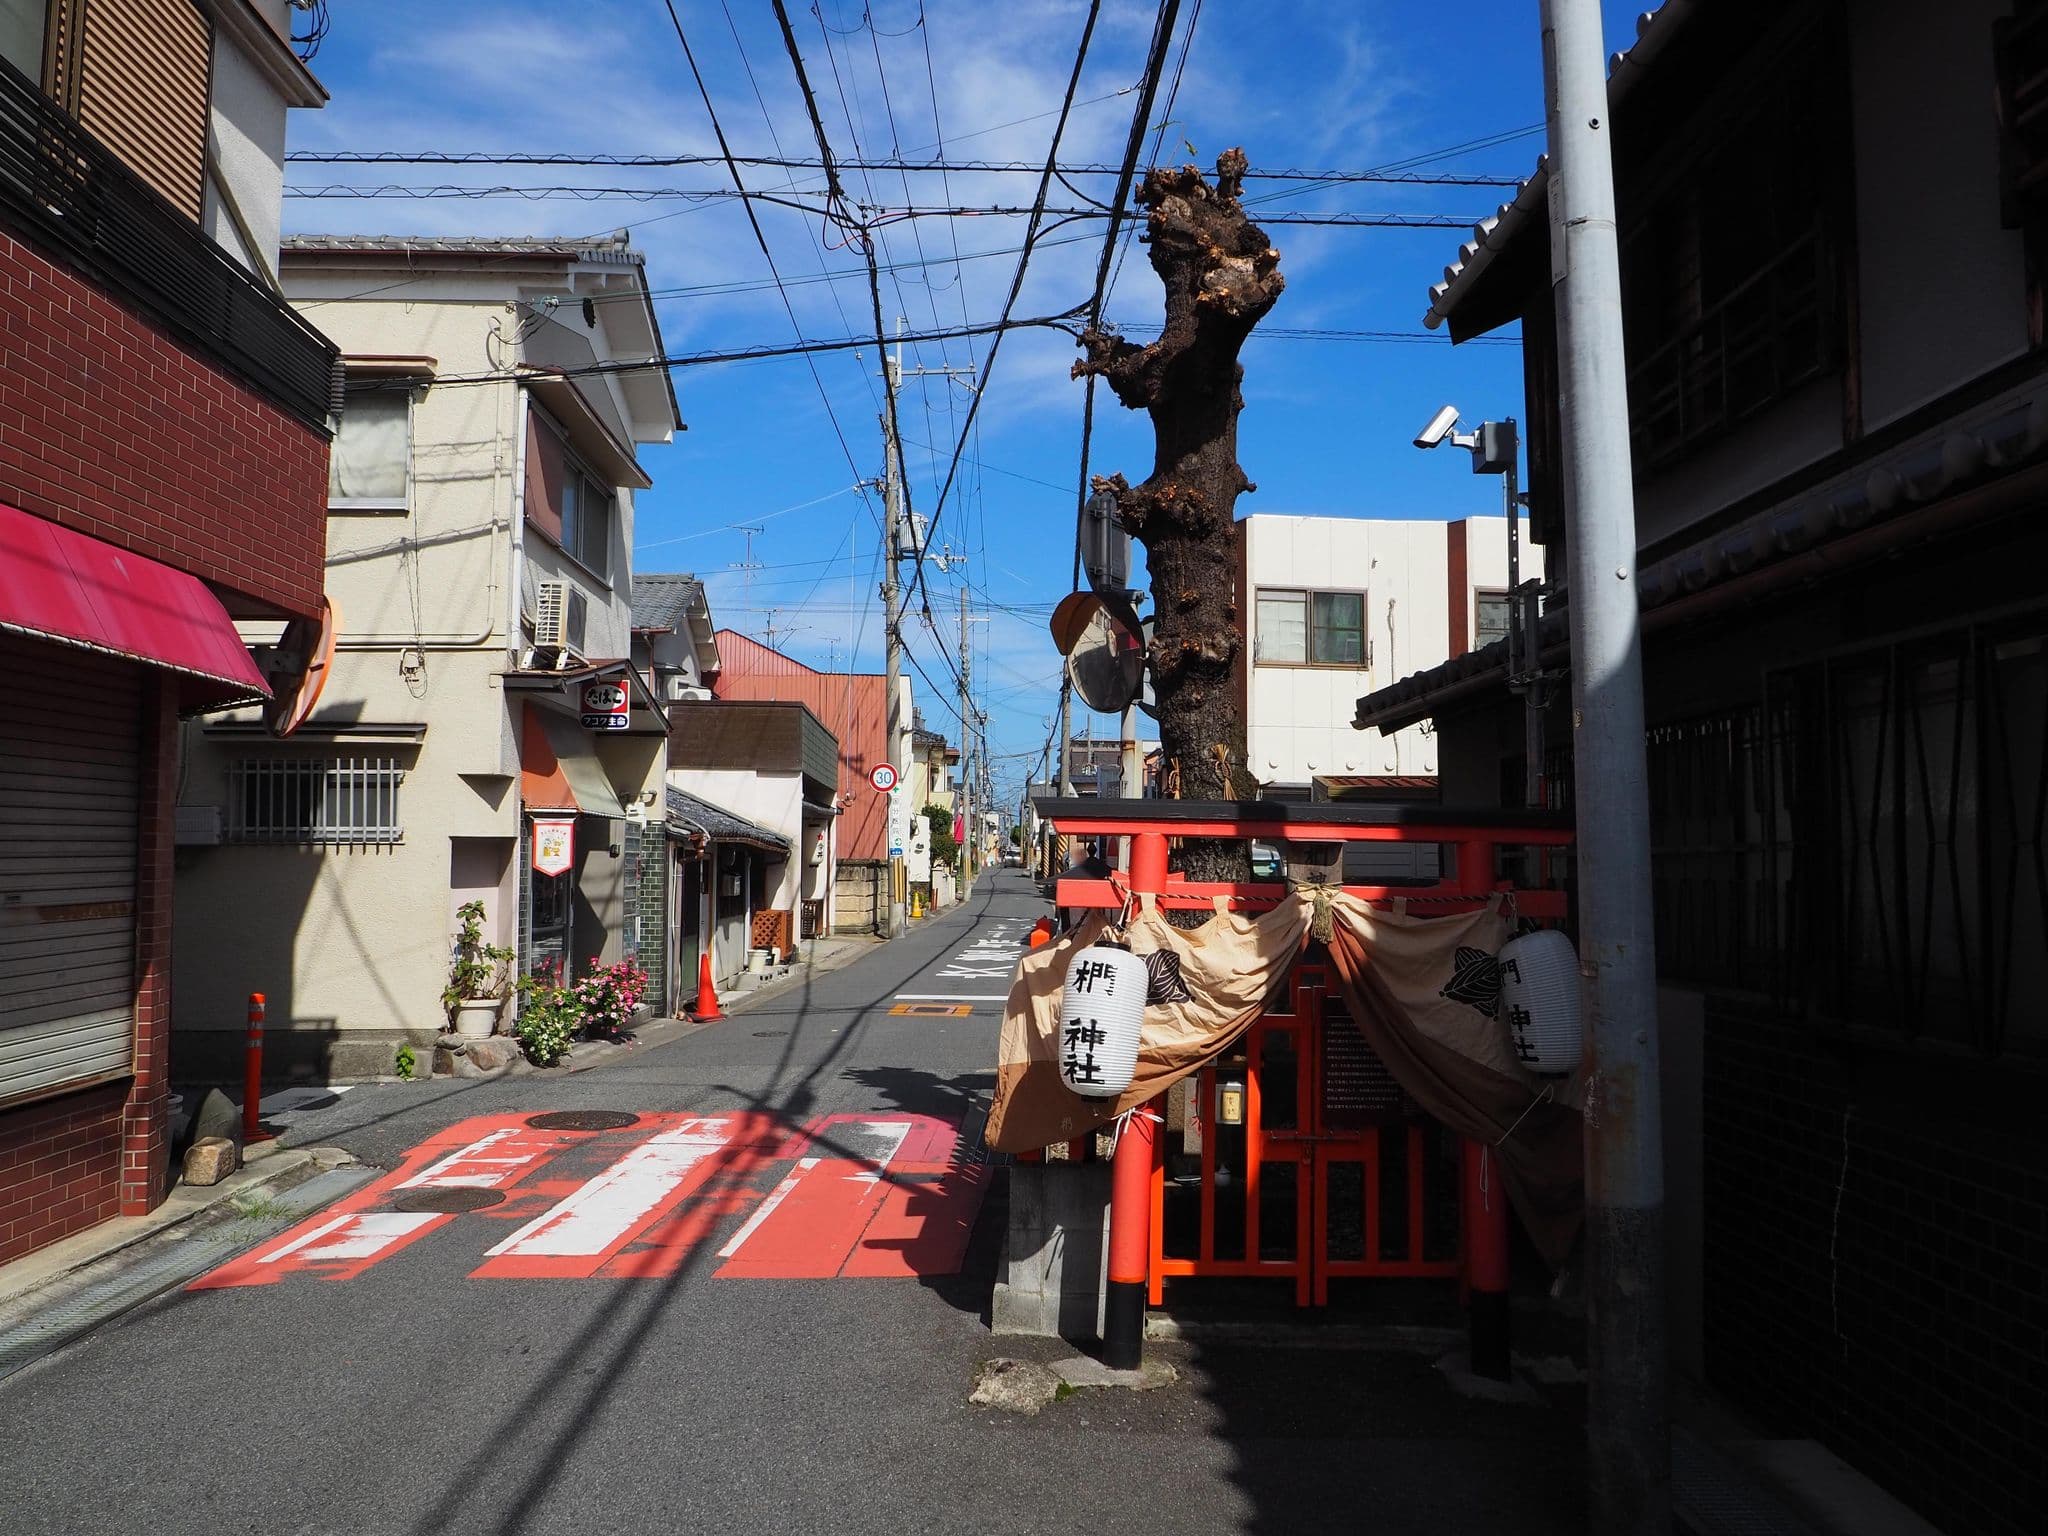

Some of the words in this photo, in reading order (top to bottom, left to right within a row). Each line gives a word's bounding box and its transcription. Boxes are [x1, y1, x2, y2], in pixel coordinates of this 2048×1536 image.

[586, 688, 622, 705] たばこ
[583, 716, 626, 726] フコク生命
[876, 771, 892, 784] 30
